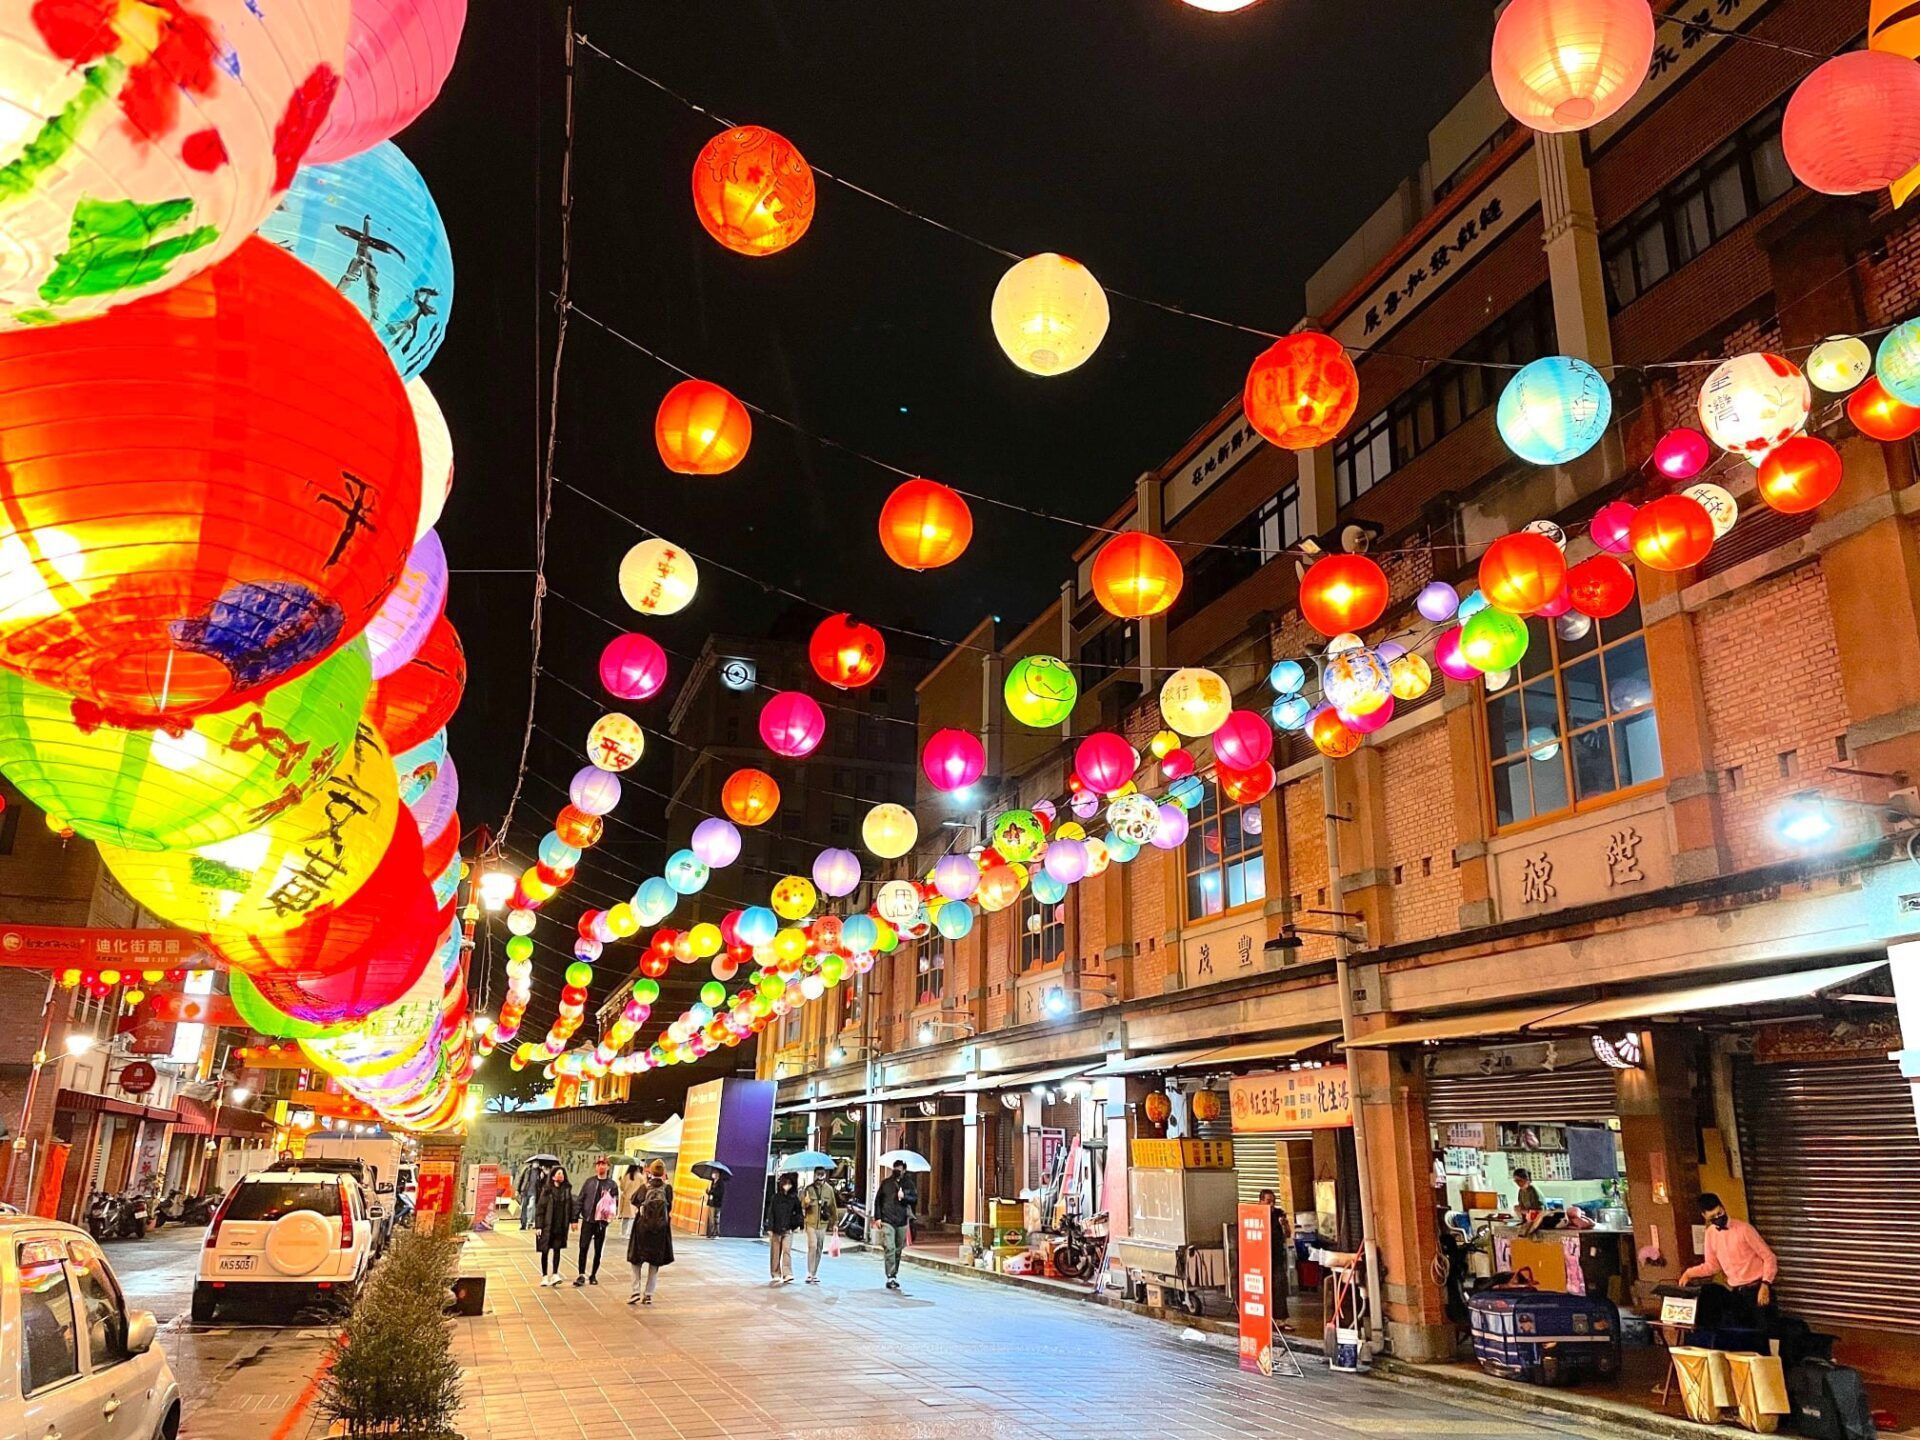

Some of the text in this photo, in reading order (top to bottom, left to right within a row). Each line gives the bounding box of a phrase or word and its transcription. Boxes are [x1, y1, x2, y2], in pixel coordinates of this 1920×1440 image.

[1650, 0, 1740, 80] 永樂
[600, 736, 635, 772] 平安
[95, 938, 180, 954] 迪化街商圈
[1317, 1079, 1350, 1113] 花生湯
